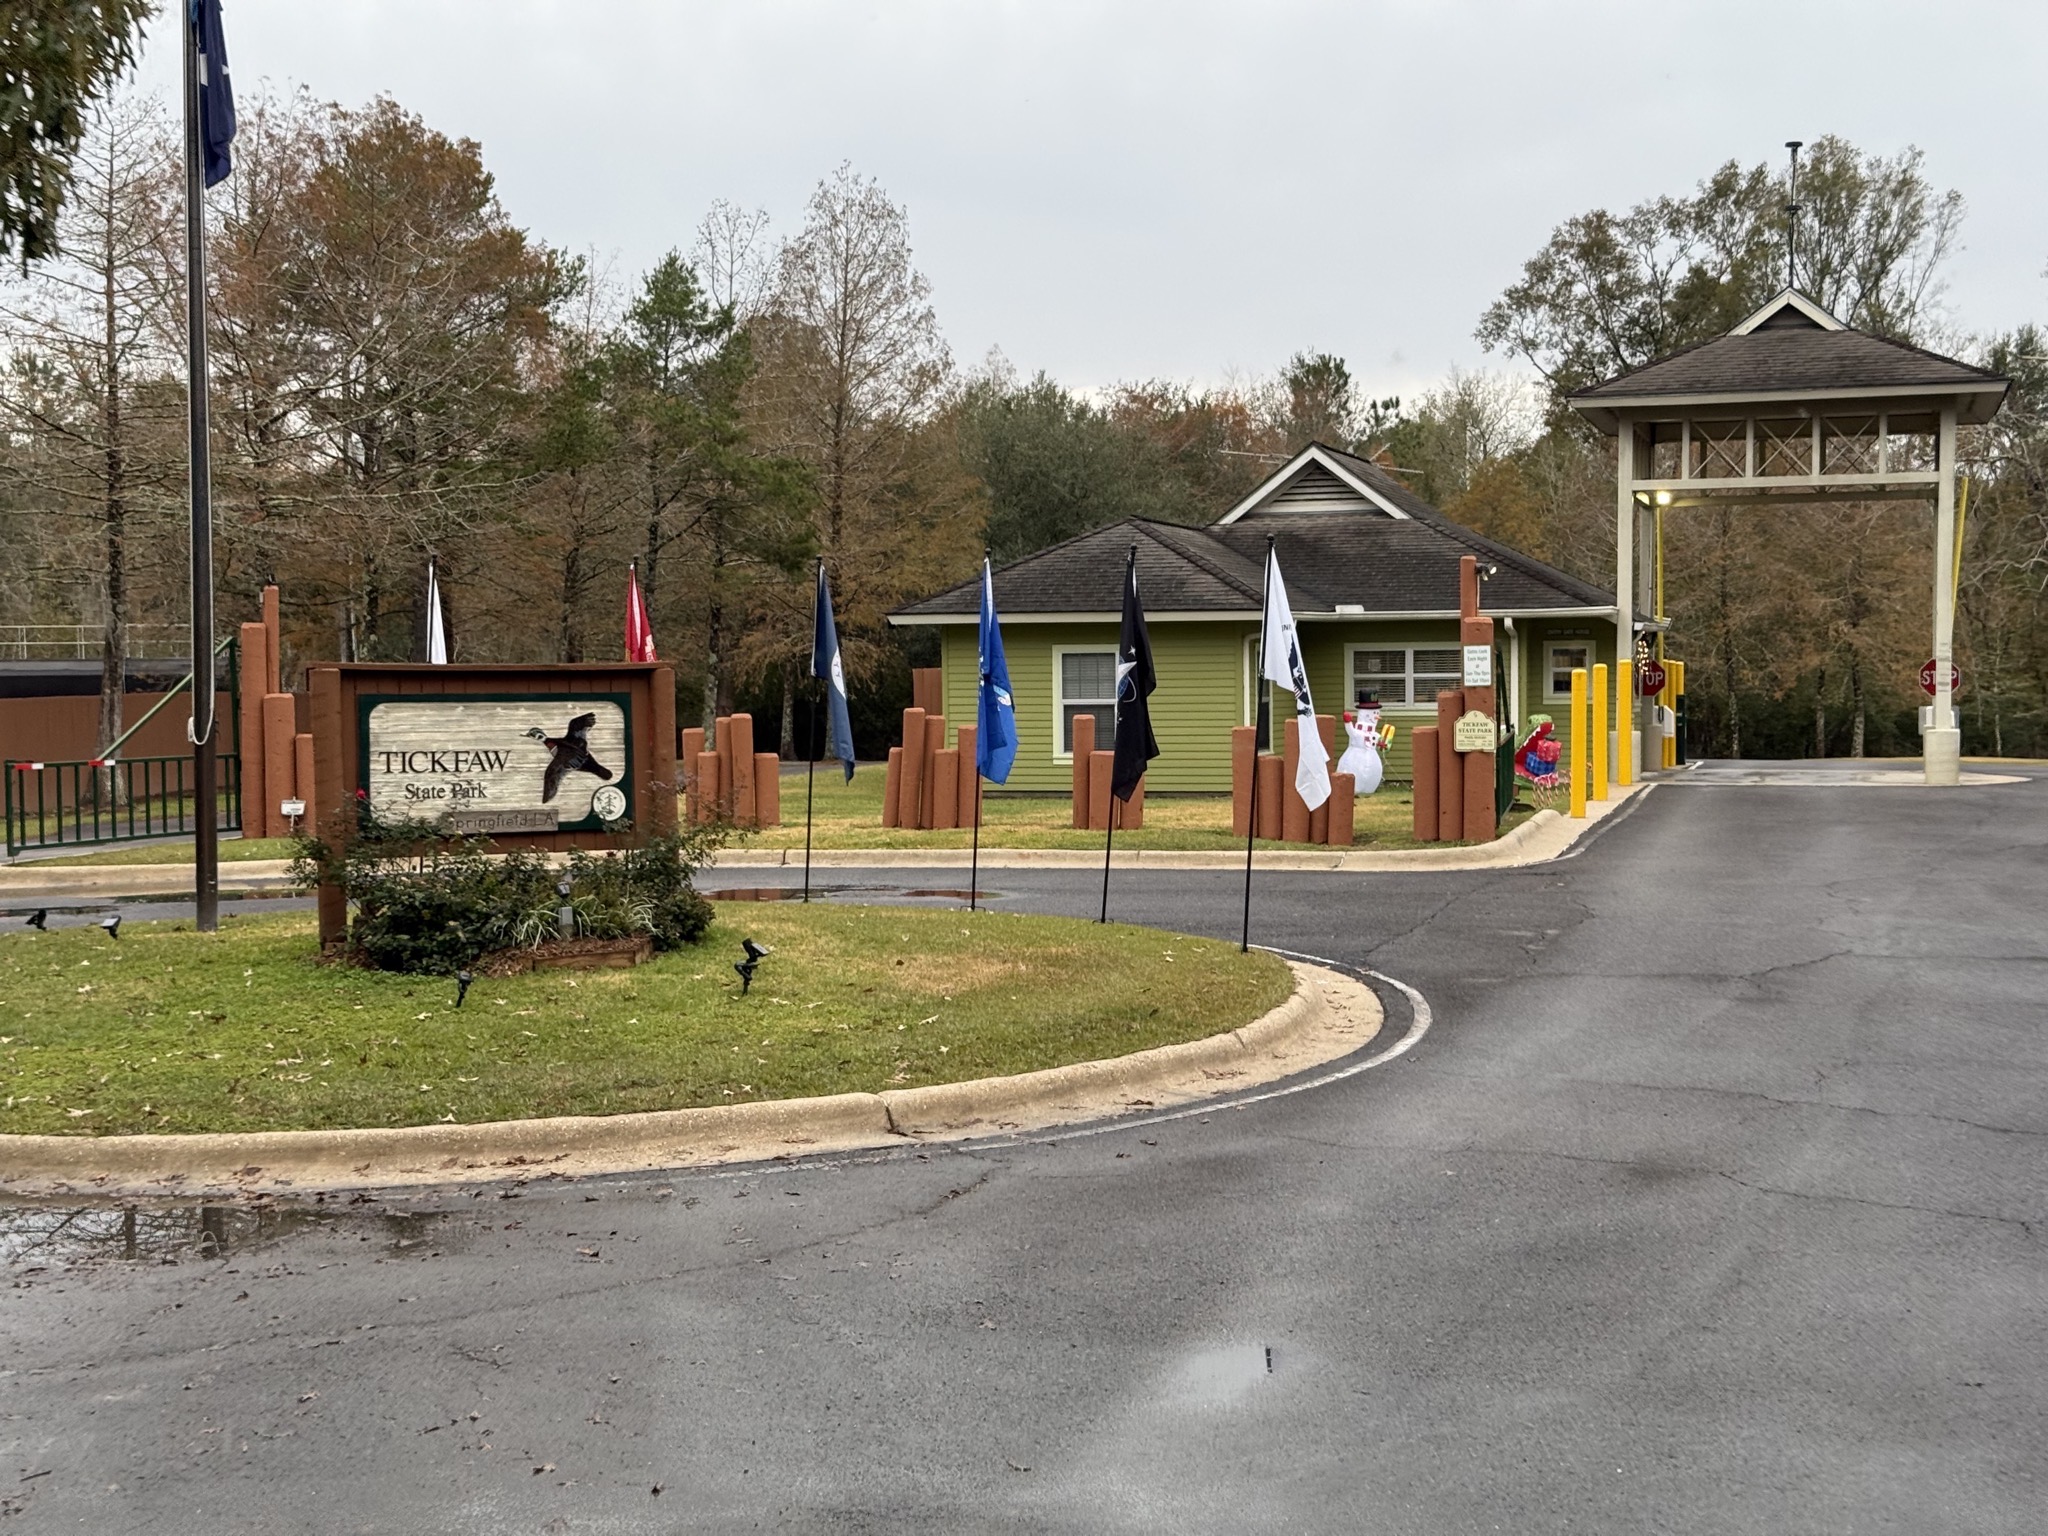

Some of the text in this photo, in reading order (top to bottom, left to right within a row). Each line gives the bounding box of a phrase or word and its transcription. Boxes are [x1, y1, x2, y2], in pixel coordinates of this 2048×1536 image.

[1921, 670, 1957, 686] STP
[378, 750, 512, 773] TICKFAW
[404, 782, 488, 800] State Park
